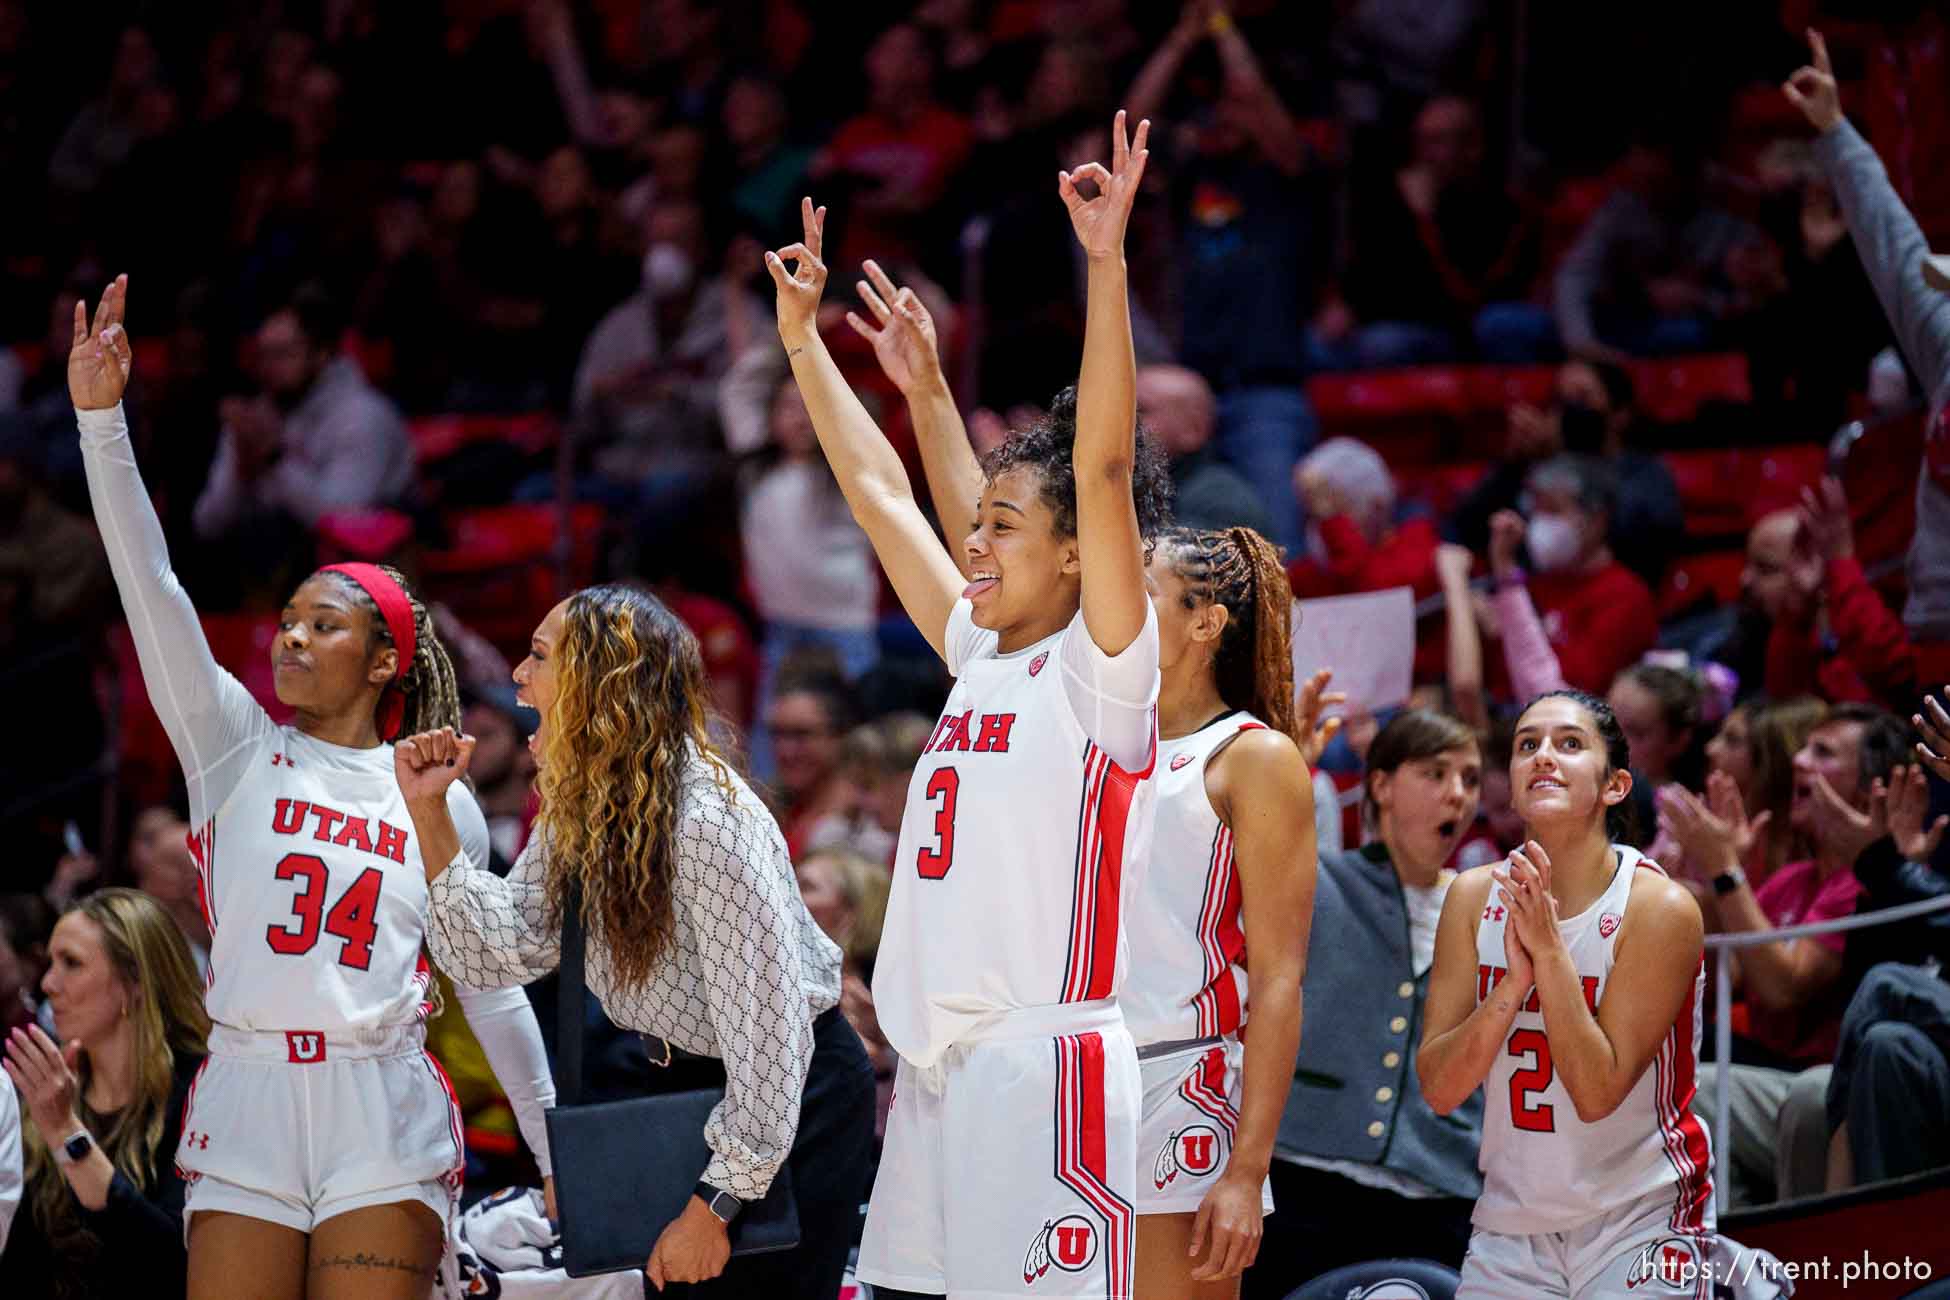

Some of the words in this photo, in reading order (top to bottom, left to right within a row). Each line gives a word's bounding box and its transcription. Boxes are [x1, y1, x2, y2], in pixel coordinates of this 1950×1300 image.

[272, 799, 408, 866] UTAH
[917, 766, 960, 880] 3
[266, 853, 383, 971] 34
[292, 1035, 318, 1058] U
[1508, 1028, 1556, 1133] 2
[1182, 1135, 1213, 1169] U
[1057, 1227, 1090, 1264] U
